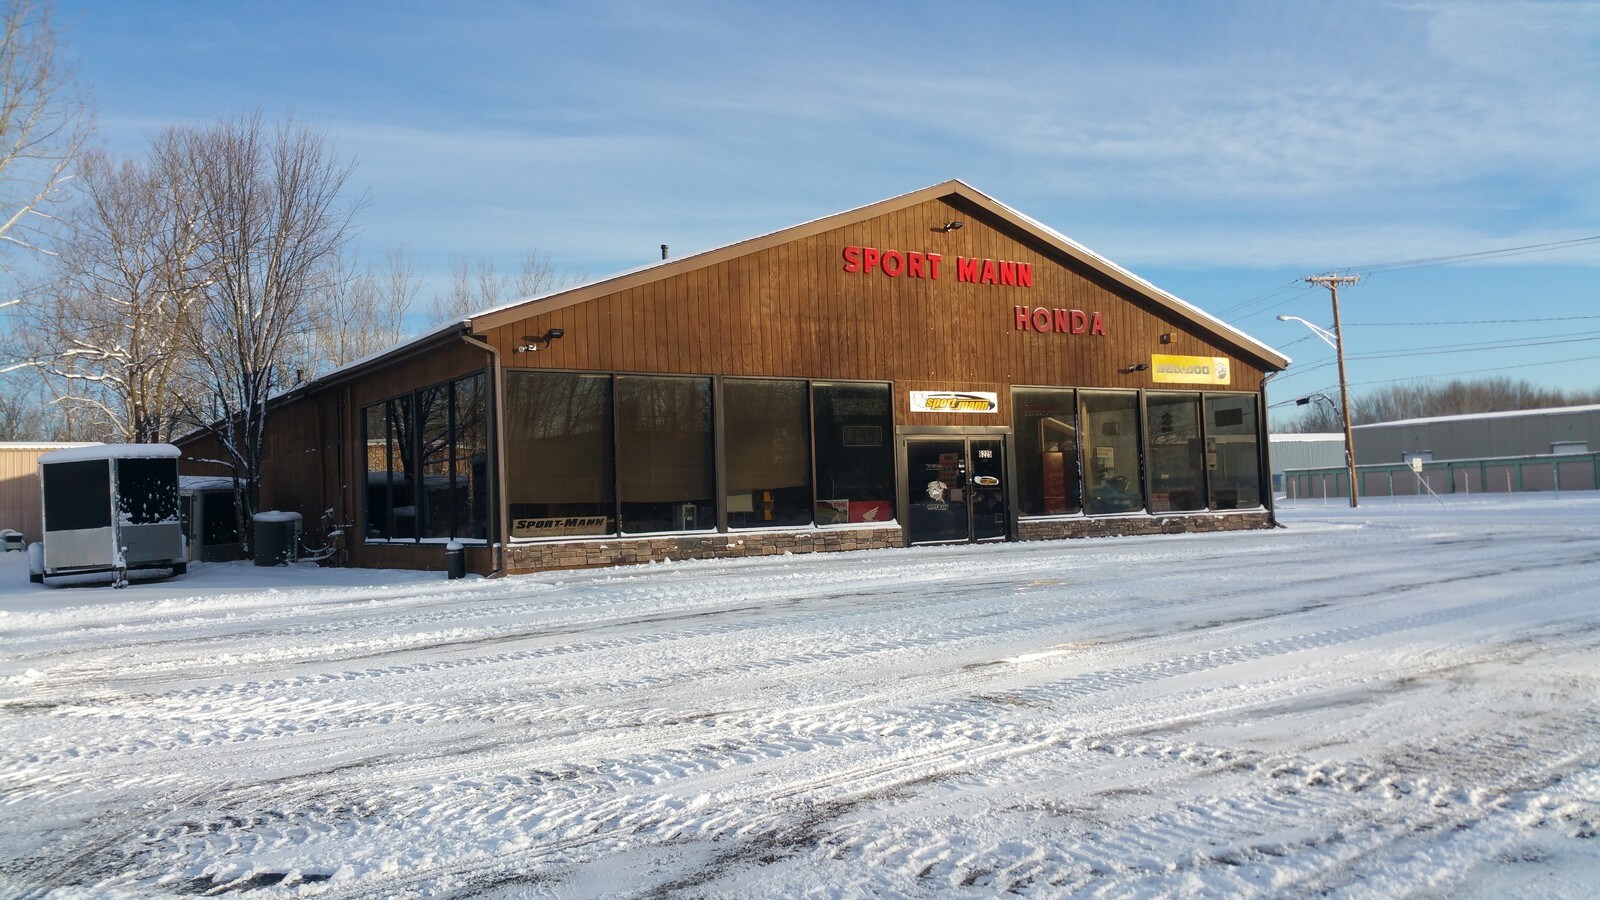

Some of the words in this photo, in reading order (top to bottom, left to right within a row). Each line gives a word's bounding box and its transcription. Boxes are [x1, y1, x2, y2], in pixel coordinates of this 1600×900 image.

[843, 246, 942, 280] SPORT
[957, 256, 1033, 288] MANN
[1014, 305, 1106, 336] HONDA
[516, 518, 605, 529] SPORT-MANN
